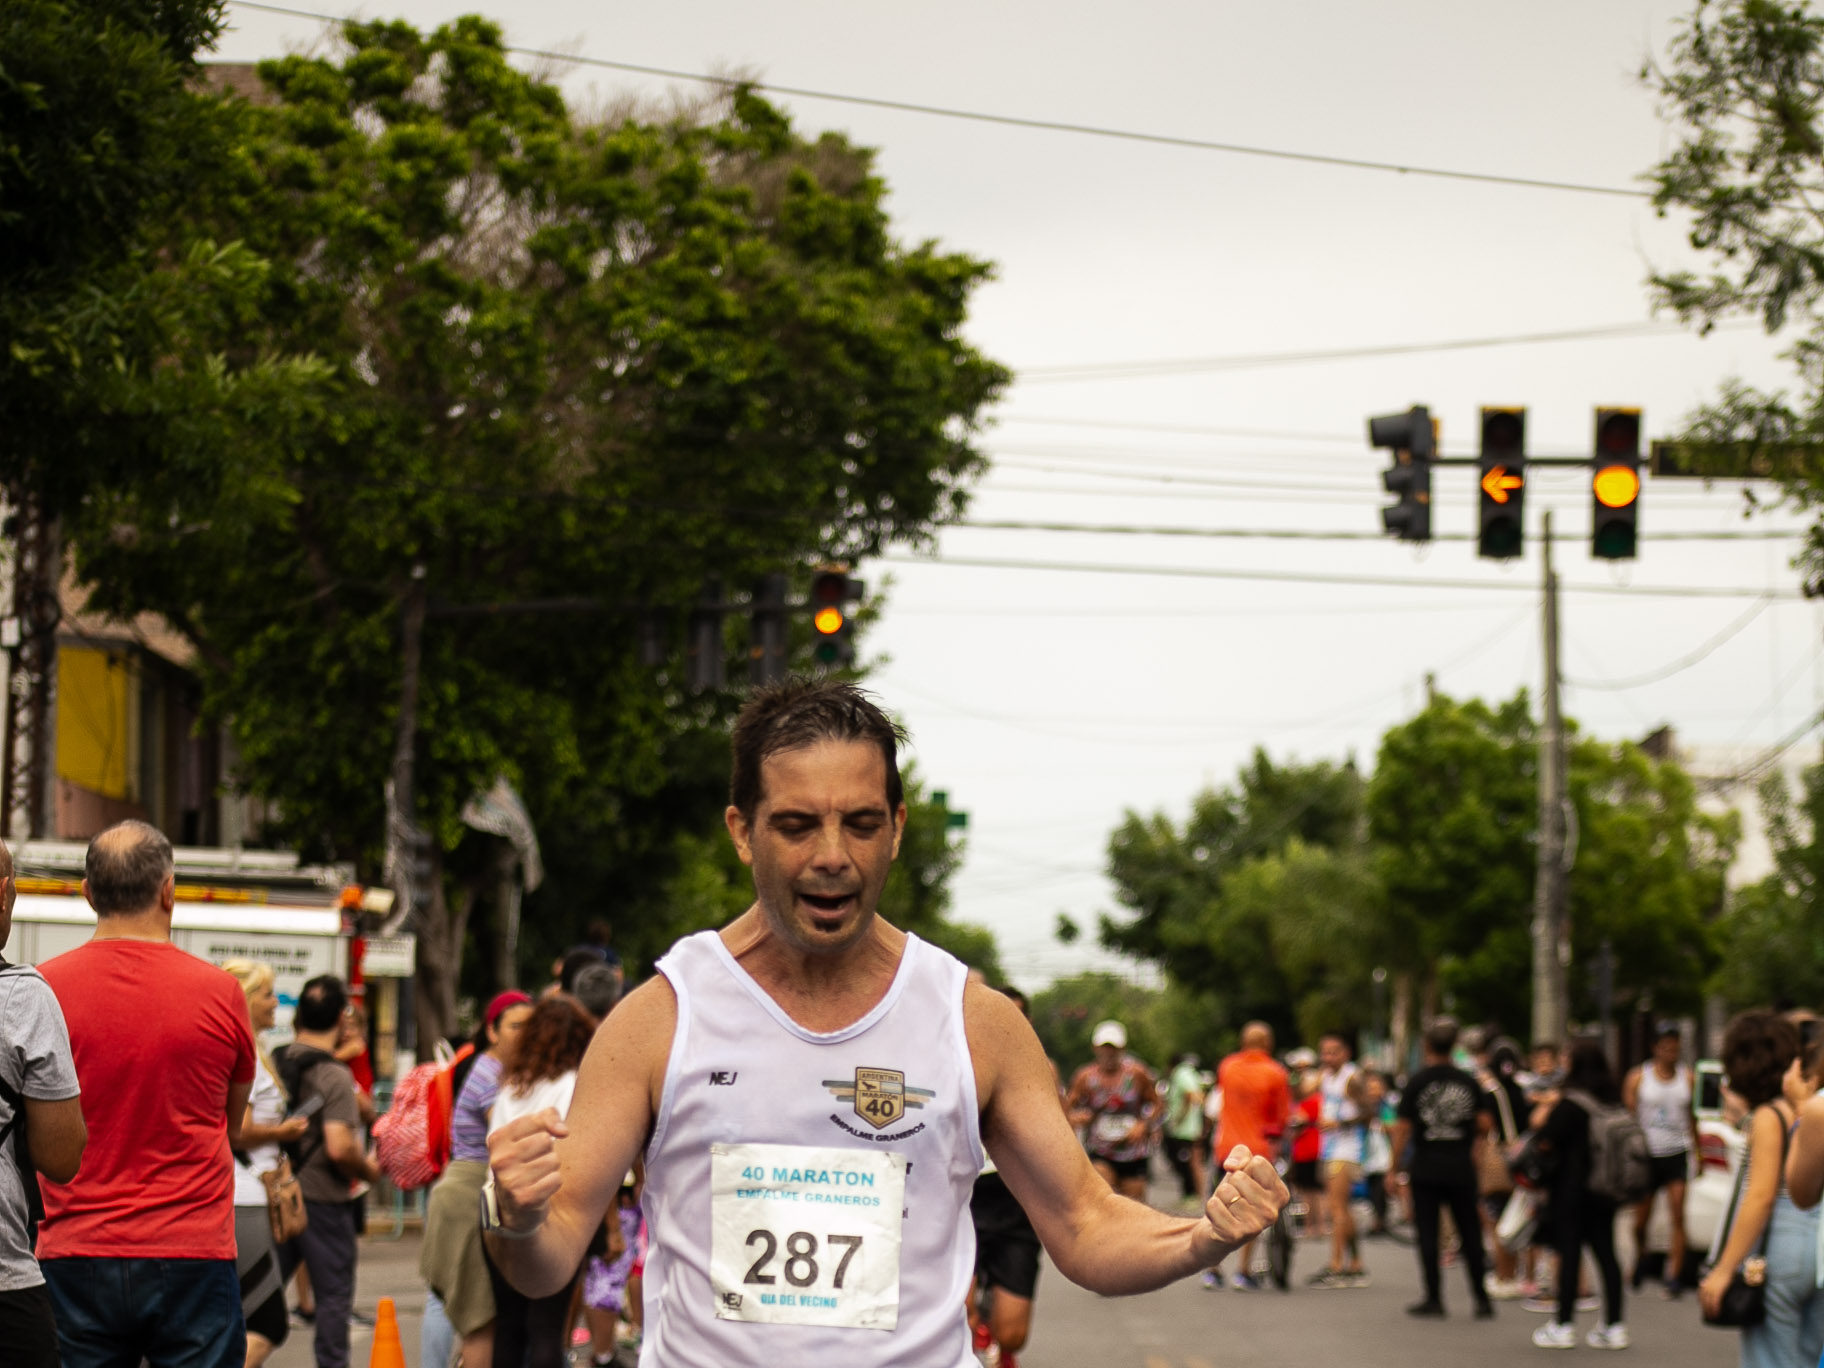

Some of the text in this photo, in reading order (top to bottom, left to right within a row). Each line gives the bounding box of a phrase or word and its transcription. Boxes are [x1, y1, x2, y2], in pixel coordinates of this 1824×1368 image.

[865, 1099, 894, 1117] 40
[829, 1114, 926, 1142] EMPALME GRANEROS
[742, 1166, 875, 1187] 40 MARATON
[736, 1189, 880, 1207] EMPALME GRANEROS
[743, 1229, 863, 1290] 287
[779, 1294, 796, 1306] DEL
[800, 1295, 838, 1308] VECINO
